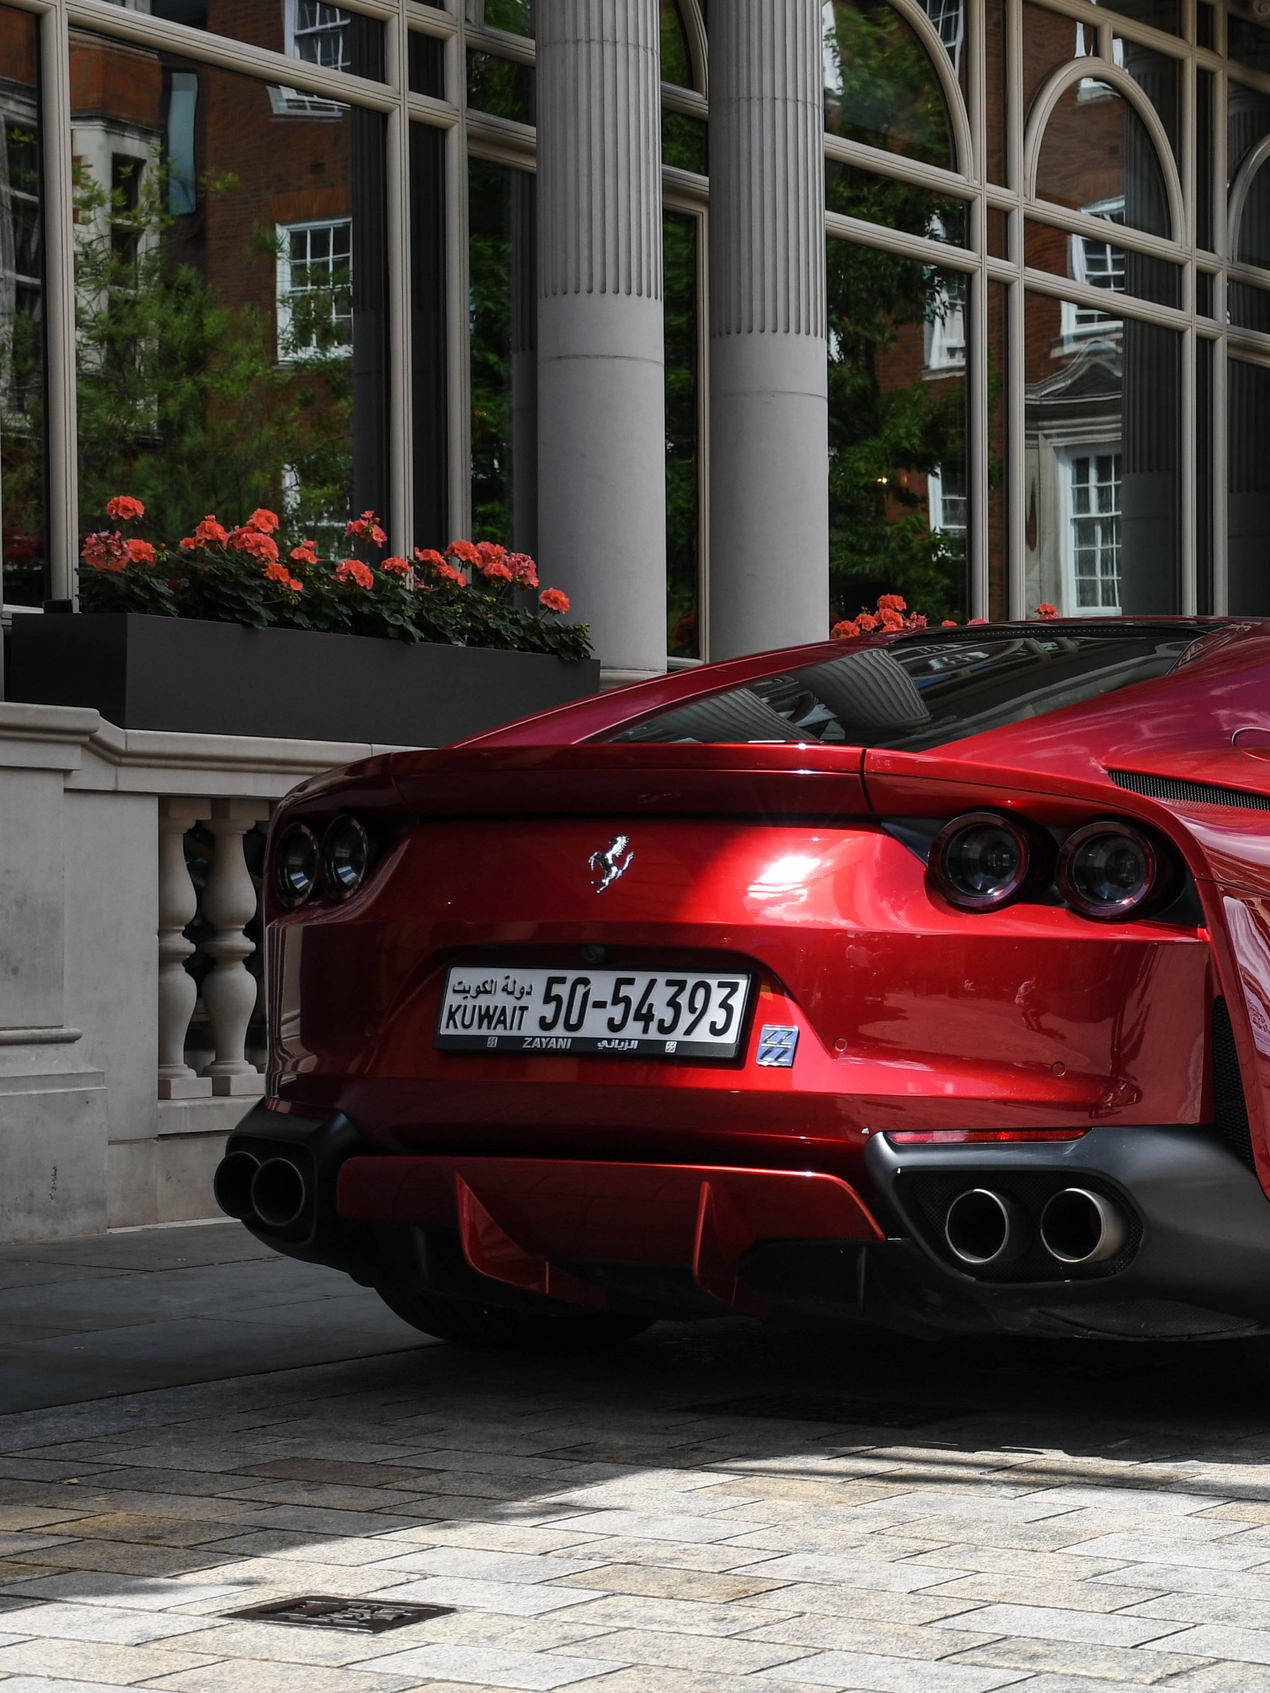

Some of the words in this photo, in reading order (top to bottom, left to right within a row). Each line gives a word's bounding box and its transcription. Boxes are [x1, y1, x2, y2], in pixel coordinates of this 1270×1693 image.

[452, 978, 498, 1000] الكويت
[501, 975, 534, 1000] دولة
[445, 1004, 530, 1031] KUWAIT
[538, 976, 741, 1038] 50-54393
[522, 1037, 573, 1050] ZAYANI
[596, 1039, 639, 1051] الزياني
